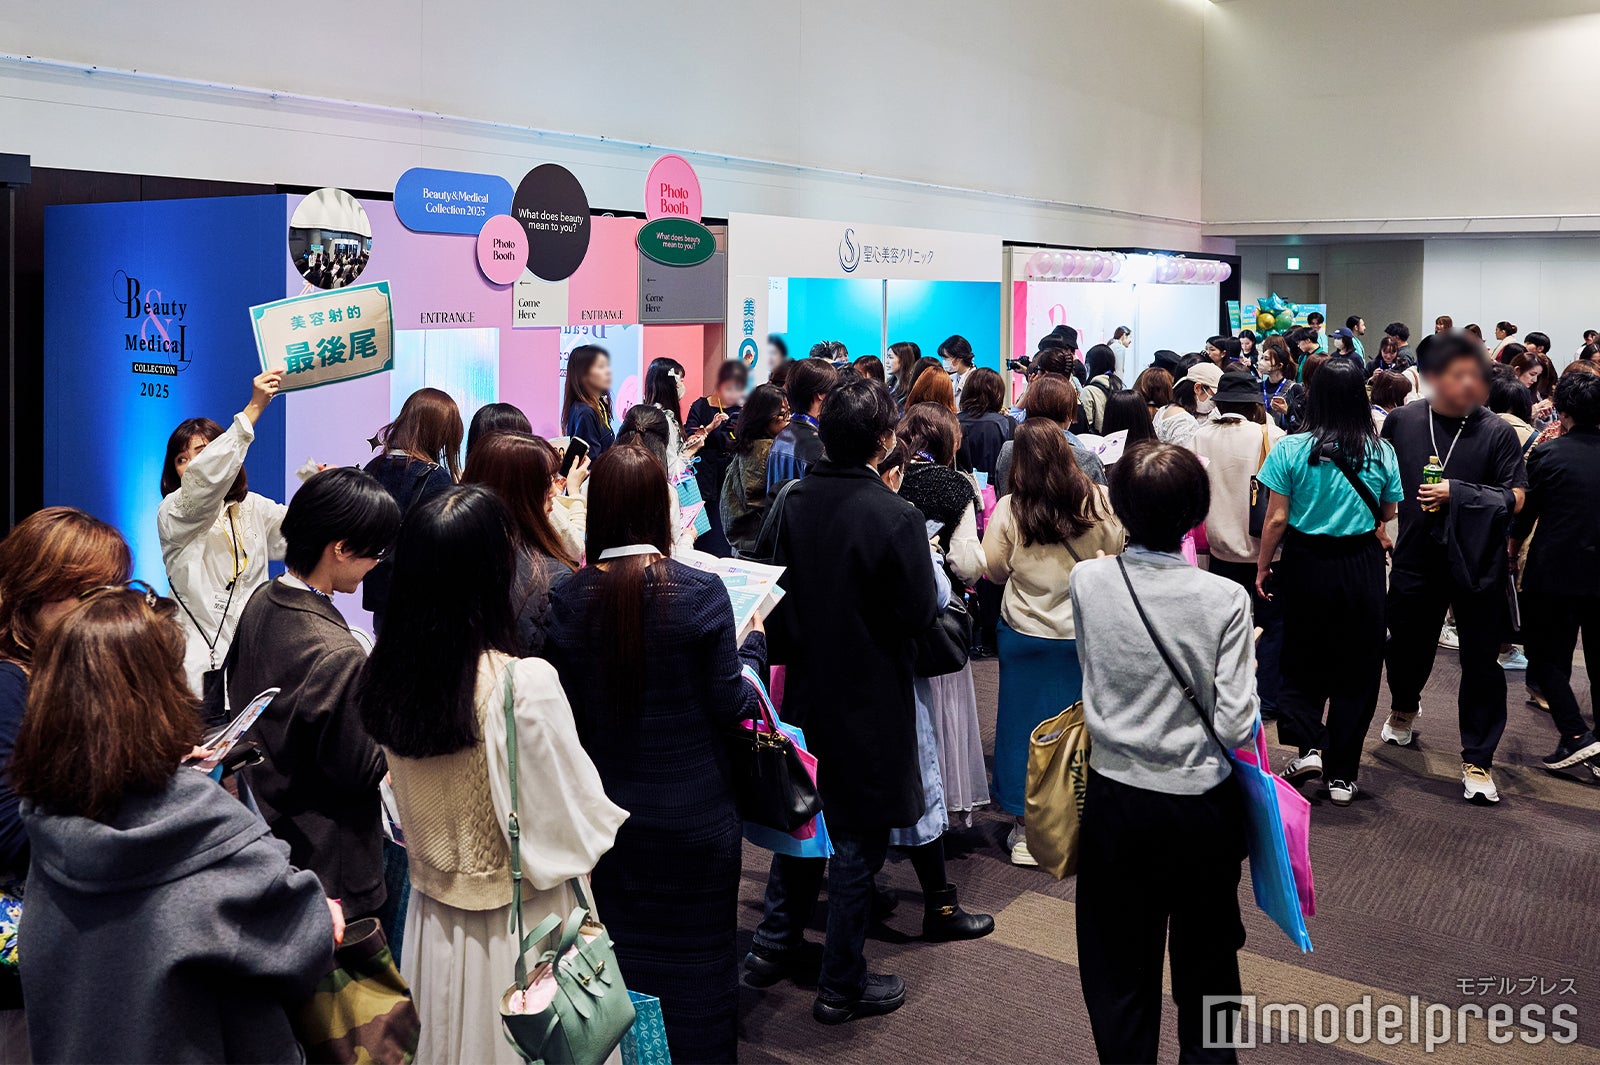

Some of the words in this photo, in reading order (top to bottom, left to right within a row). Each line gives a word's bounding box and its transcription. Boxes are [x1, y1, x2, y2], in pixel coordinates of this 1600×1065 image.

[660, 183, 689, 199] Photo
[425, 202, 466, 215] Collection
[466, 205, 486, 216] 2025
[660, 198, 689, 215] Booth
[518, 208, 539, 219] What
[540, 210, 559, 221] does
[560, 212, 584, 225] beauty
[528, 222, 549, 230] mean
[550, 223, 559, 231] to
[559, 223, 577, 234] you?
[493, 238, 515, 249] Photo
[656, 232, 670, 241] What
[671, 232, 683, 241] does
[684, 234, 700, 245] beauty
[493, 250, 515, 261] Booth
[863, 245, 934, 264] 聖心美容クリニック
[113, 270, 187, 321] Beauty
[645, 293, 664, 302] Come
[518, 298, 541, 308] Come
[645, 303, 661, 312] Here
[291, 305, 361, 331] 美容射的
[420, 311, 475, 324] ENTRANCE
[518, 309, 537, 320] Here
[581, 310, 624, 320] ENTRANCE
[283, 328, 378, 375] 最後尾
[134, 363, 176, 375] COLLECTION
[140, 382, 169, 398] 2025
